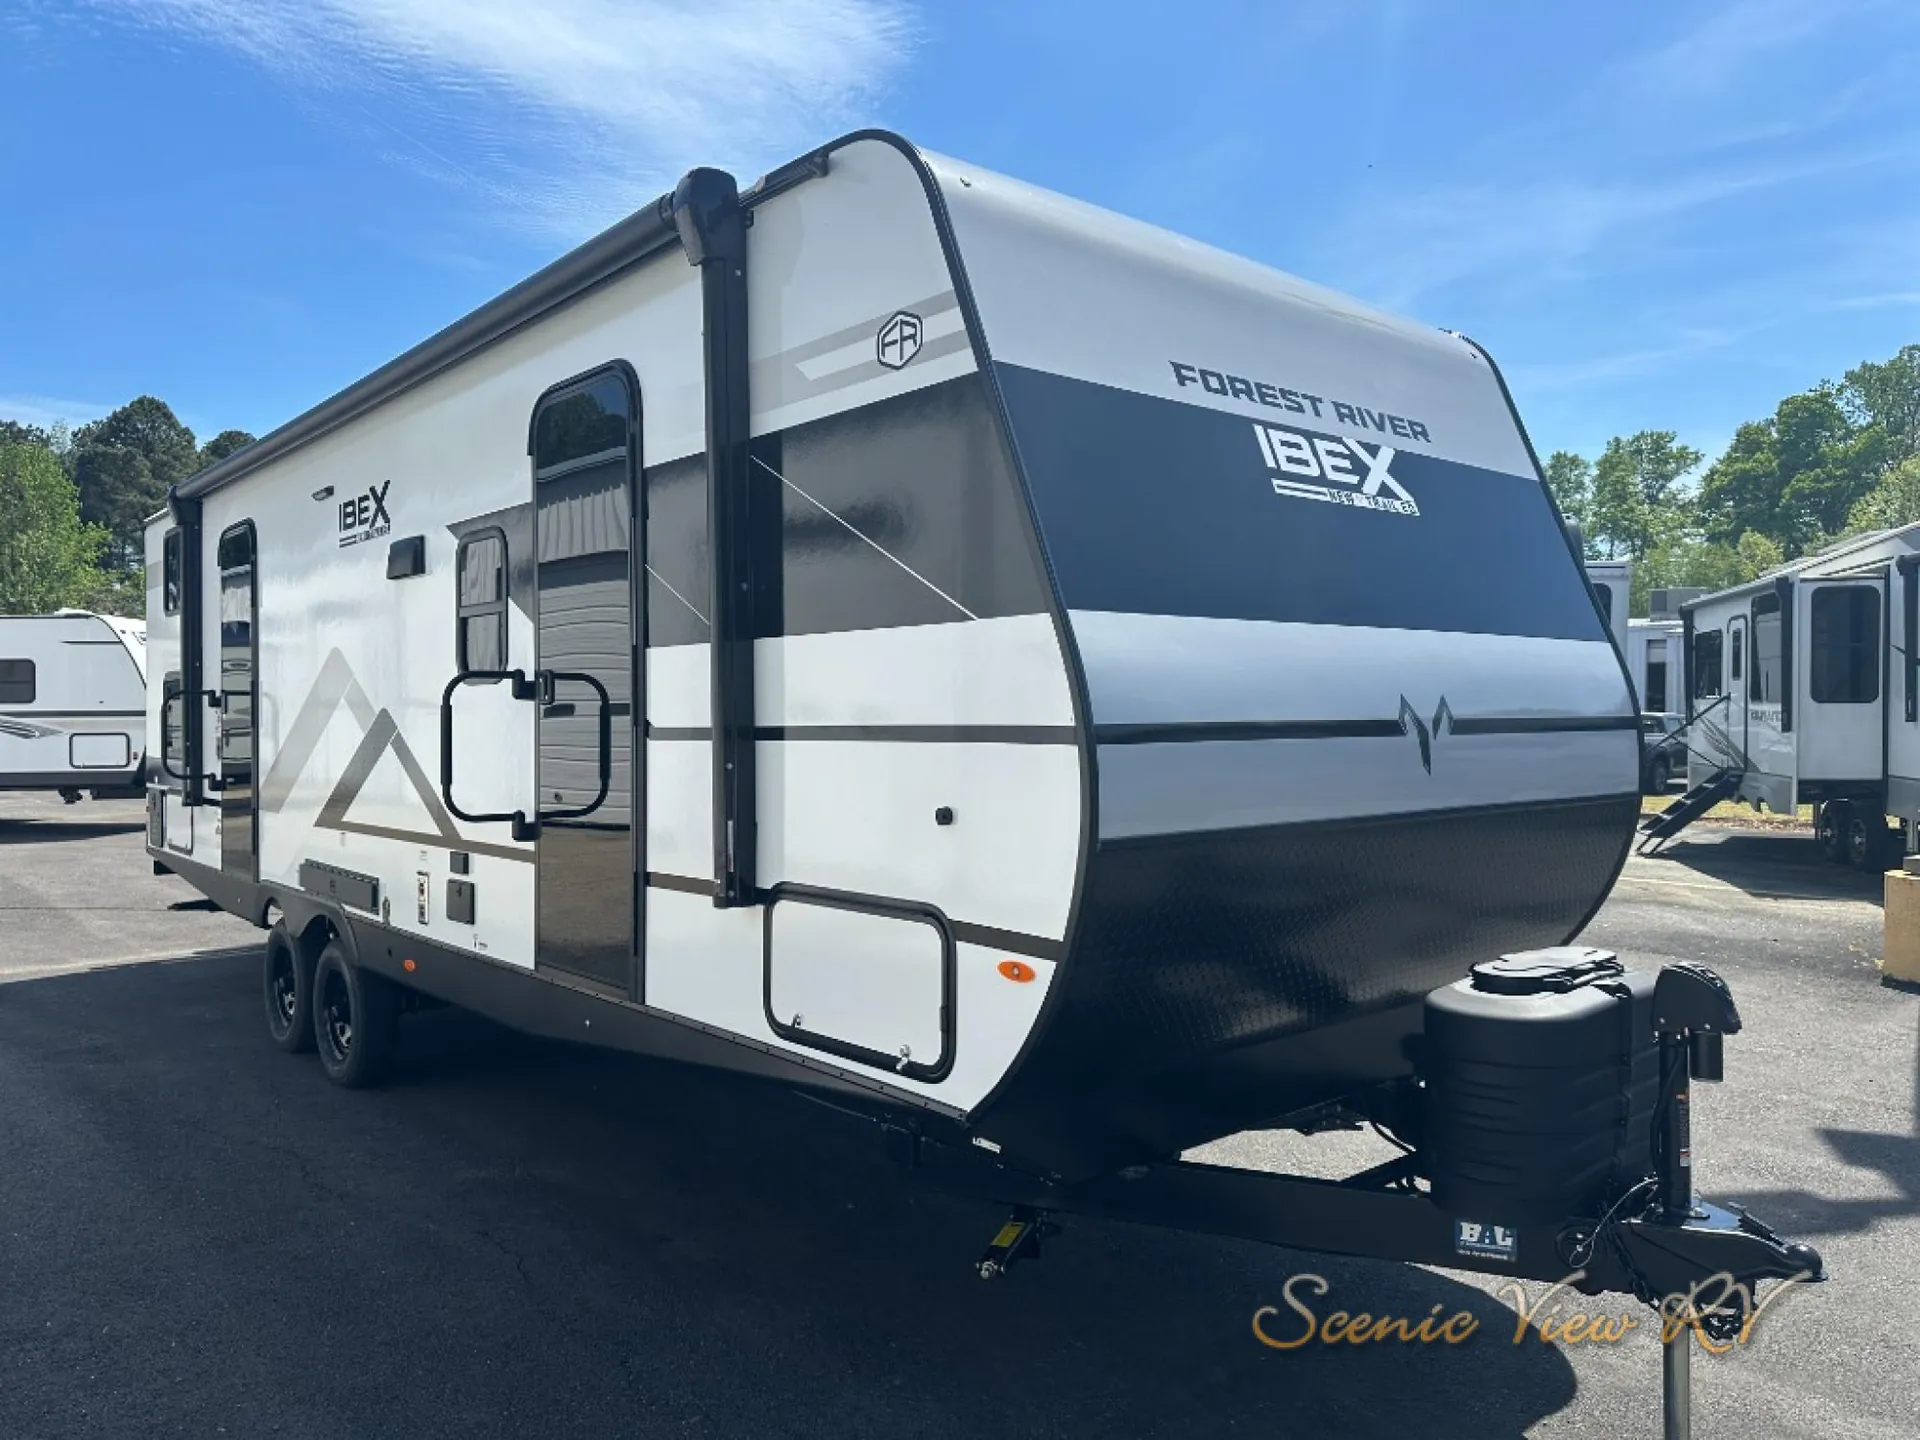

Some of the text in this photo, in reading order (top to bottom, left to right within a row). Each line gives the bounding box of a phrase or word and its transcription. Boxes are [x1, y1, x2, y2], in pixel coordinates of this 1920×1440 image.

[1168, 360, 1431, 443] FOREST RIVER
[1252, 424, 1416, 503] IBEX
[339, 480, 391, 532] IBEX
